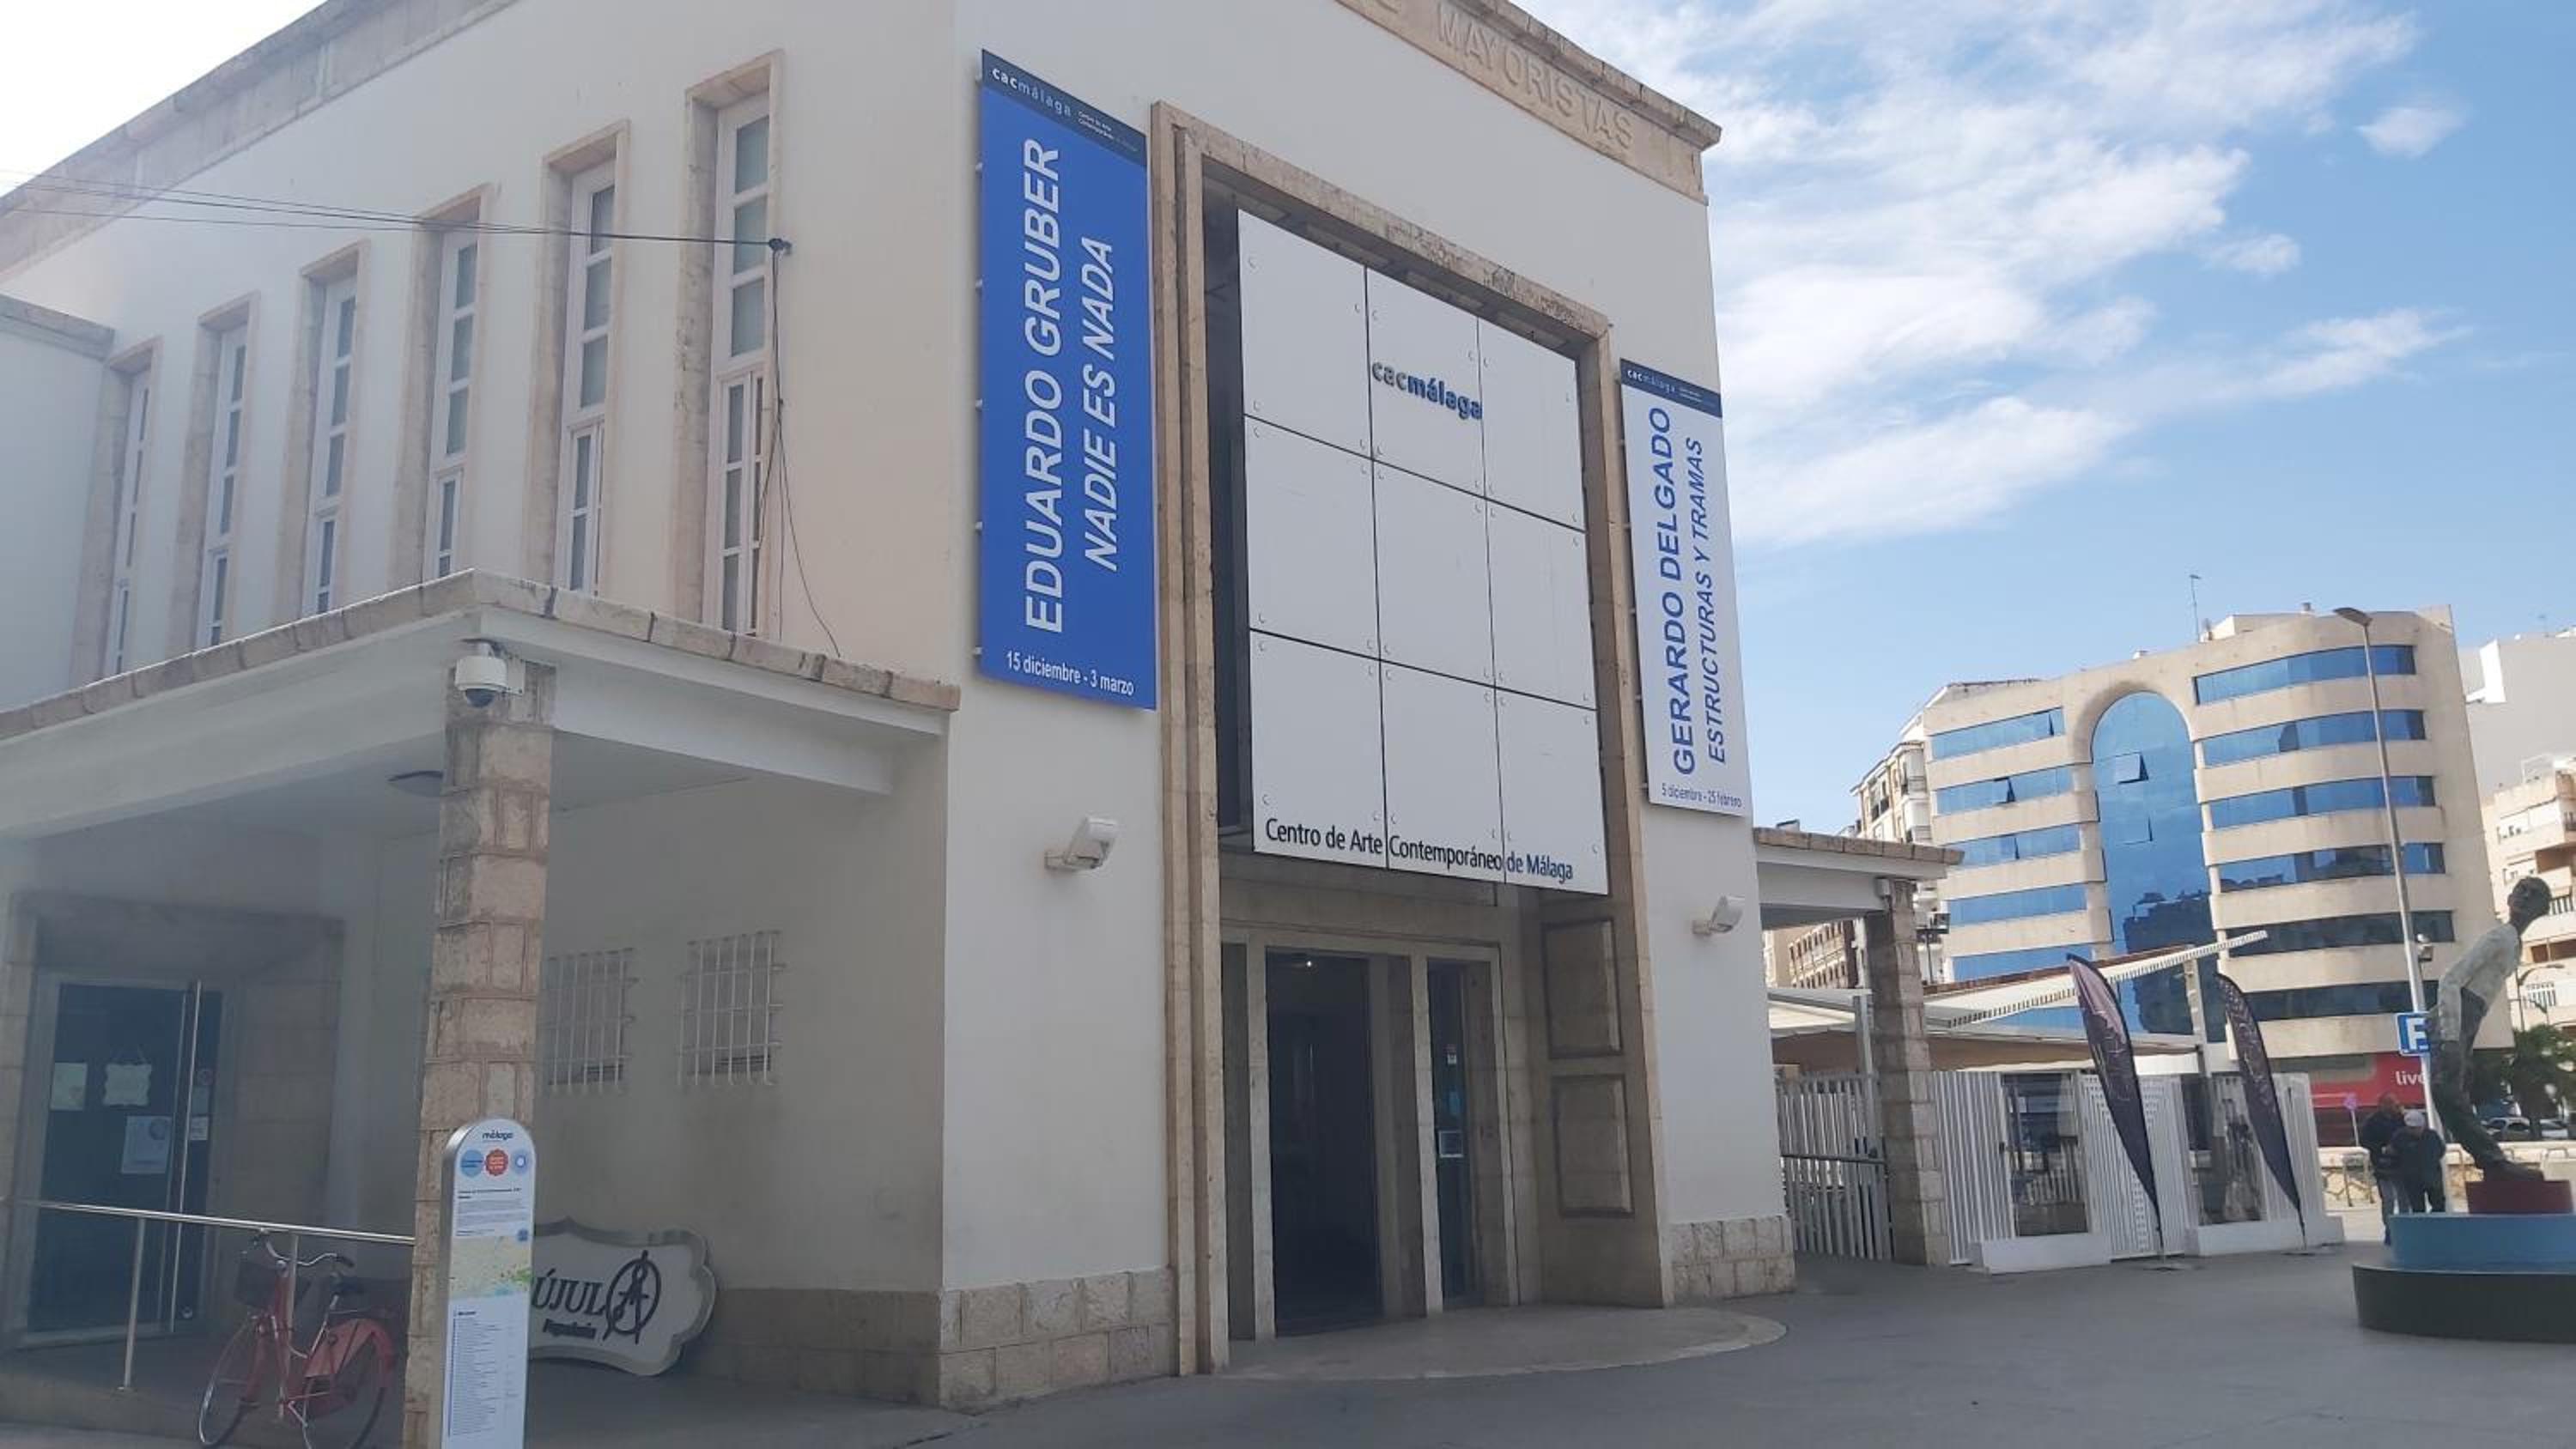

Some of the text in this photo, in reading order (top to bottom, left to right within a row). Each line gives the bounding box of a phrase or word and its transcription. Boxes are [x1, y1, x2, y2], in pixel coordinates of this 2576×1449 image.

[1437, 3, 1631, 149] MAYORISTAS
[1024, 138, 1063, 633] EDUARDO GRUBER
[1081, 236, 1117, 573] NADIE ES NADA
[1371, 361, 1483, 420] cacmálaga
[1006, 650, 1022, 671] 15
[1023, 654, 1082, 684] diciembre
[1090, 670, 1097, 688] 3
[1100, 675, 1134, 696] marzo
[1648, 407, 1696, 775] GERARDO DELGADO
[1685, 436, 1726, 765] ESTRUCTURAS Y TRAMAS
[1266, 817, 1574, 885] Centro de Arte Contemporáneo de Málaga
